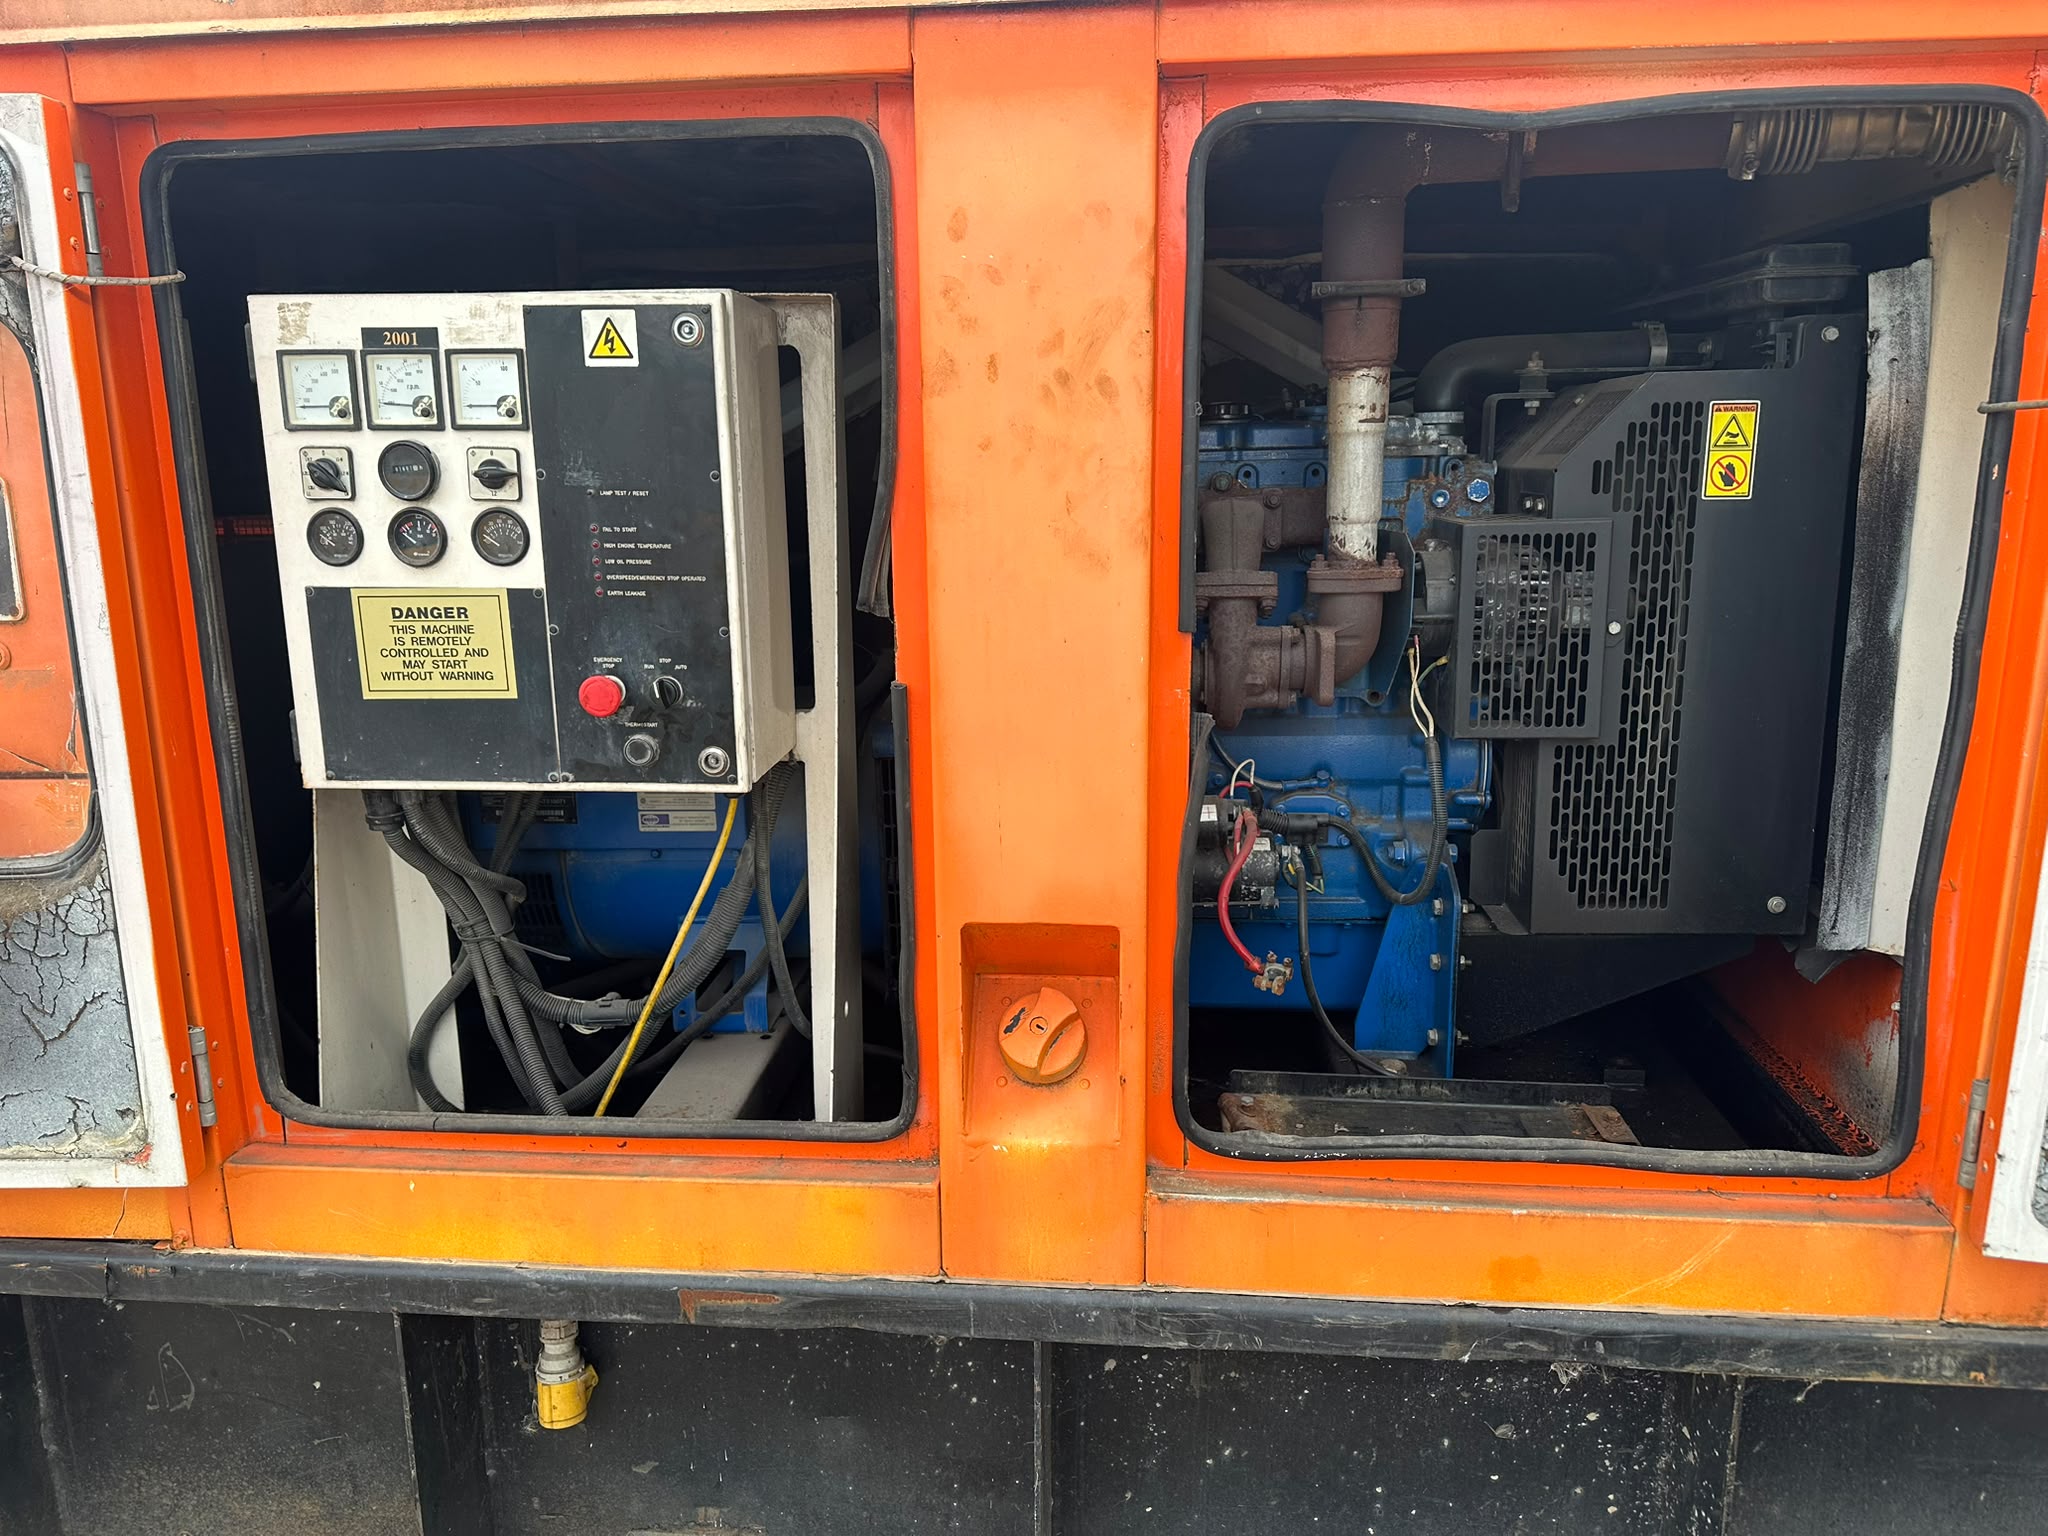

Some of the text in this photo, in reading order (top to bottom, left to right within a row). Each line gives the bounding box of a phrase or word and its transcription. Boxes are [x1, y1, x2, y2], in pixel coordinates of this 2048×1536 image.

[383, 331, 418, 346] 2001
[391, 607, 469, 619] DANGER
[389, 624, 475, 635] THIS MACHINE
[394, 636, 472, 646] IS REMOTELY
[380, 648, 489, 658] CONTROLLED AND
[402, 659, 468, 669] MAY START
[380, 671, 494, 681] WITHOUT WARNING
